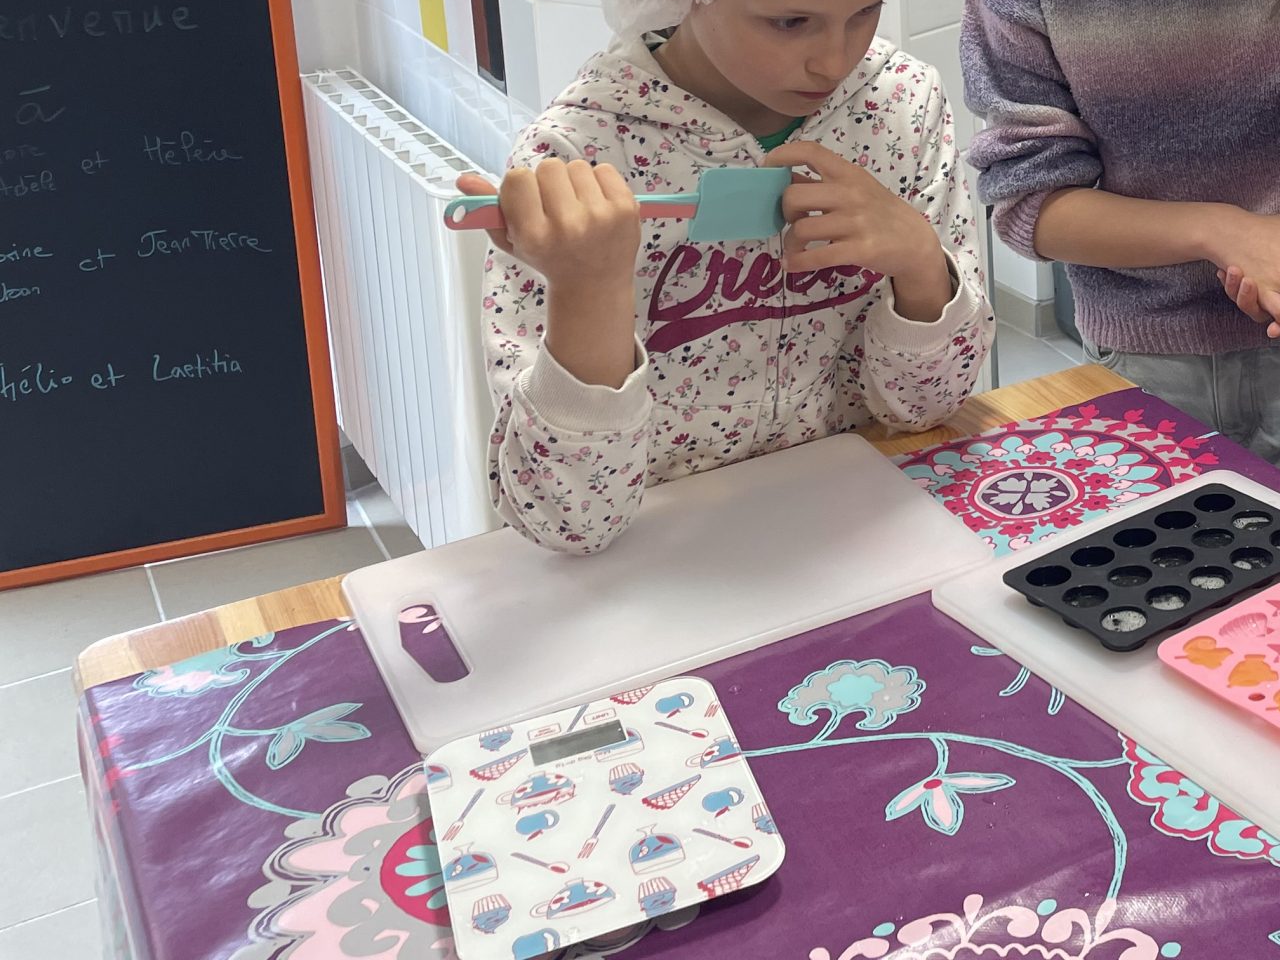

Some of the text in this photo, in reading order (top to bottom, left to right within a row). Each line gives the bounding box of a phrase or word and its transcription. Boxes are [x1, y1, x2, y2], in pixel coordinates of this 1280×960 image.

[81, 151, 111, 175] et
[78, 248, 116, 272] et
[91, 363, 126, 390] et
[151, 348, 243, 383] Laetitia
